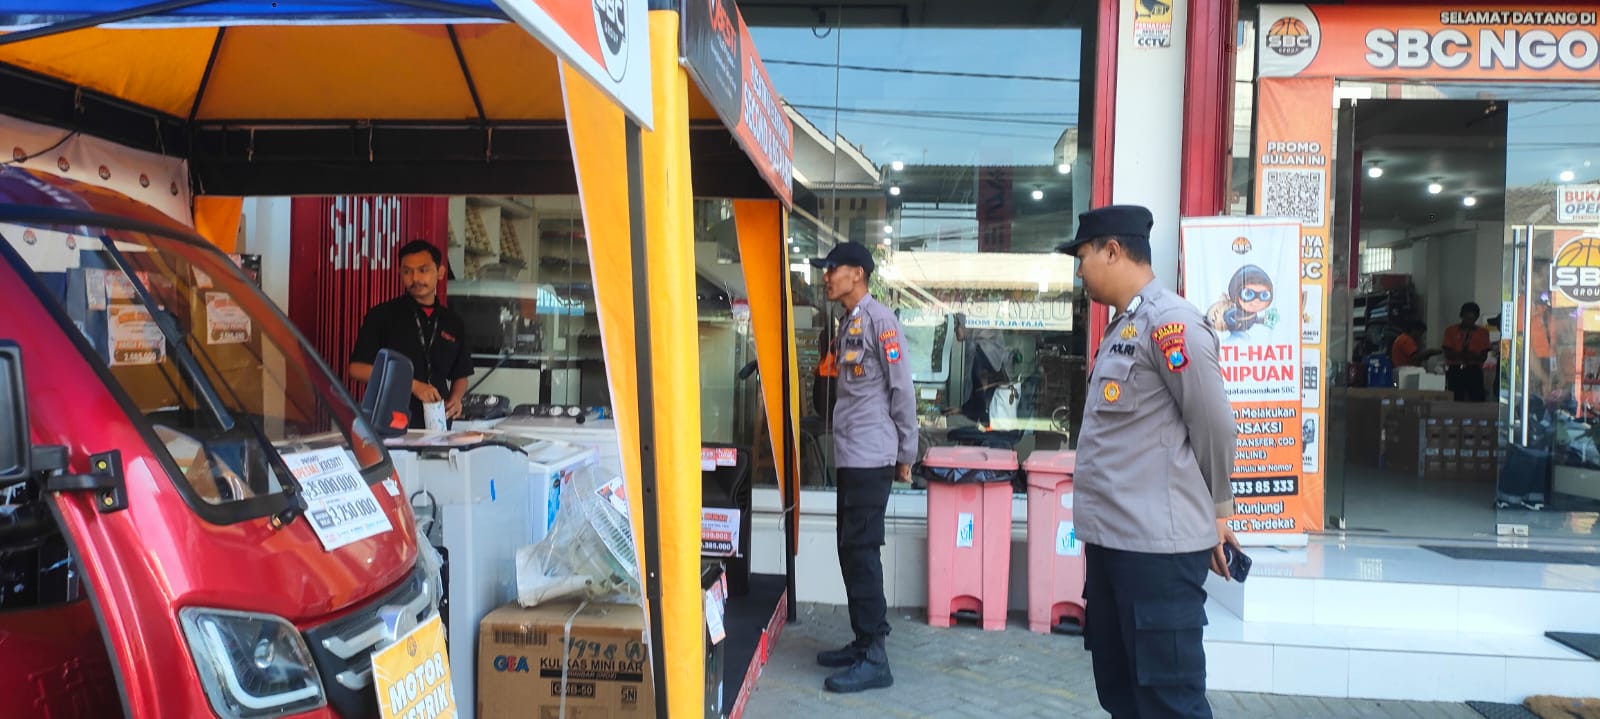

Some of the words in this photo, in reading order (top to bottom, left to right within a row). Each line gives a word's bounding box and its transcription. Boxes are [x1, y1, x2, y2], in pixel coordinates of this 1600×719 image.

[1440, 11, 1510, 24] SELAMAT
[1512, 11, 1577, 24] DATANG
[1579, 12, 1596, 24] DI
[1137, 38, 1166, 47] CCTV
[1268, 35, 1310, 48] SBC
[1365, 29, 1471, 68] SBC
[1267, 141, 1321, 153] PROMO
[1261, 154, 1305, 165] BULAN
[1308, 155, 1326, 165] INI
[1242, 407, 1296, 419] Melakukan
[1278, 436, 1296, 446] COD
[1268, 463, 1293, 472] Nomor
[1255, 480, 1271, 493] 85
[1272, 479, 1294, 492] 333
[1237, 501, 1284, 515] Kunjungi
[1226, 519, 1249, 532] SBC
[1250, 517, 1296, 530] Terdekat
[493, 655, 530, 673] GEA
[591, 659, 617, 672] MINI
[618, 660, 643, 673] BAR
[389, 651, 446, 716] MOTOR
[403, 681, 449, 719] TRIK
